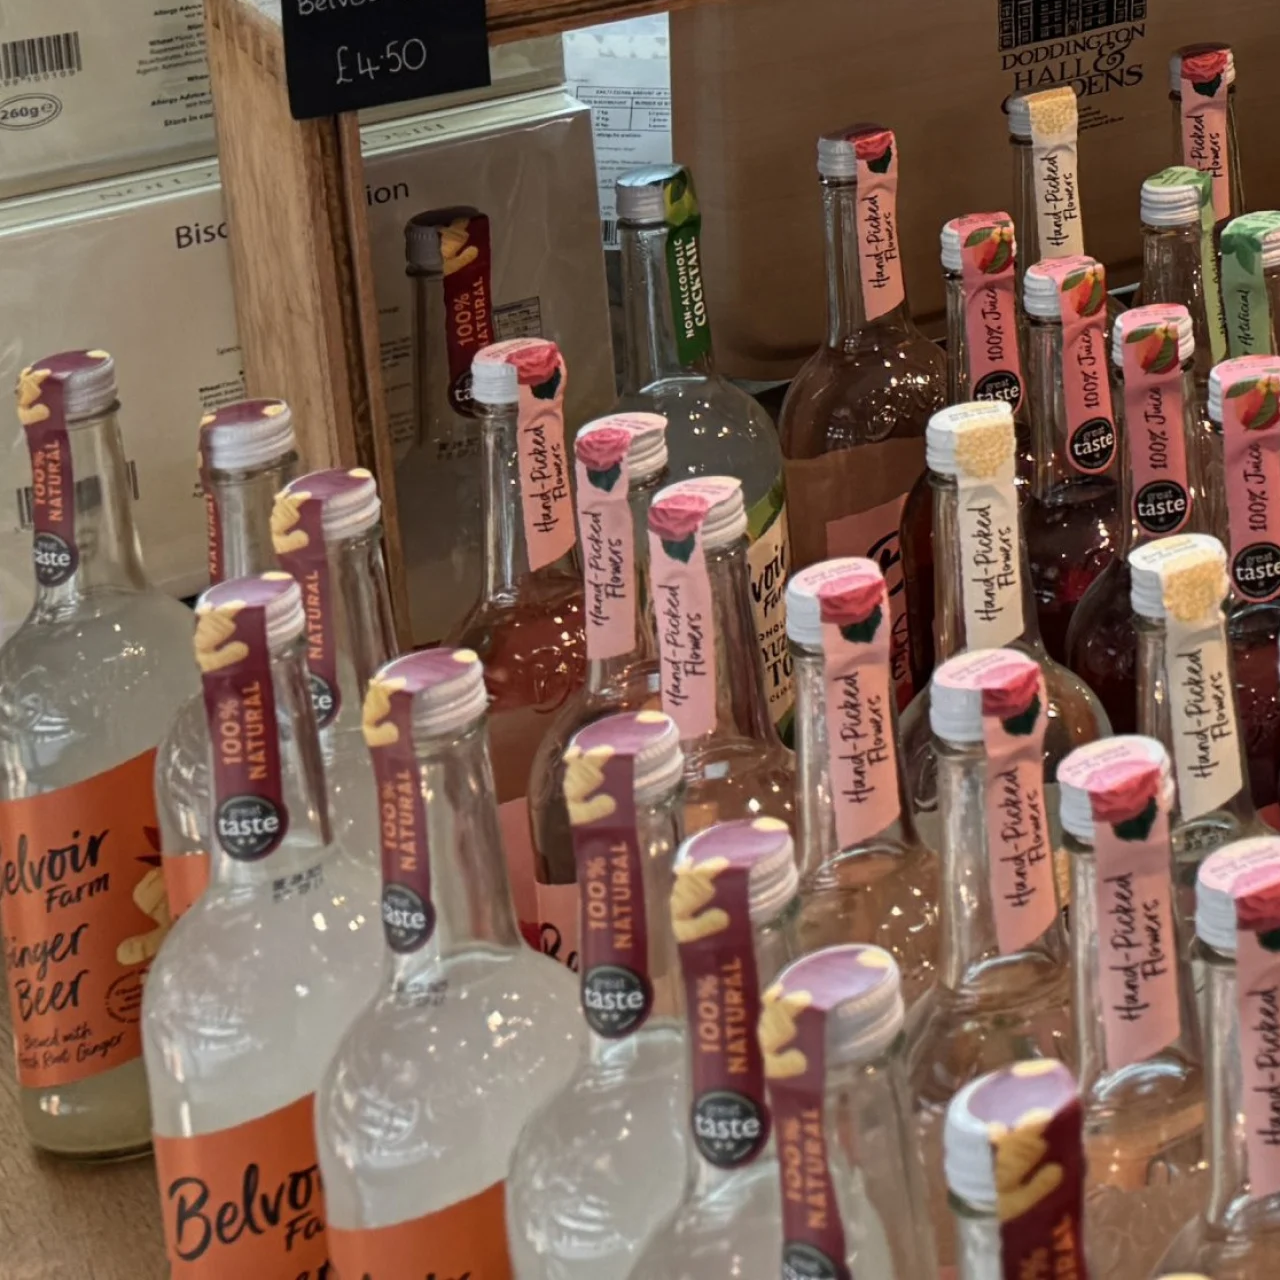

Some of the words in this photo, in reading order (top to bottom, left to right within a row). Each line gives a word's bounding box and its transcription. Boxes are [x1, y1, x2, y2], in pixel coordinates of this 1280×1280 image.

[336, 38, 427, 85] £4.50
[1001, 24, 1145, 71] DODDINGTON
[1014, 58, 1091, 91] HALL
[1093, 40, 1132, 72] &
[0, 107, 39, 120] 260g
[863, 194, 888, 290] Hand-Picked
[1044, 153, 1064, 249] Hand-Picked
[673, 236, 695, 340] NON-ALCOHOLIC
[685, 236, 706, 327] COCKTAIL
[48, 439, 63, 522] NATURAL
[529, 422, 551, 534] Hand-Picked
[1073, 432, 1114, 456] taste
[1137, 496, 1186, 518] taste
[972, 503, 993, 624] Hand-Picked
[308, 569, 324, 661] NATURAL
[833, 671, 874, 806] Hand-Picked
[1176, 648, 1219, 779] Hand-Picked
[0, 829, 110, 898] elvoir
[218, 814, 280, 837] taste
[997, 766, 1032, 909] Hand-Picked
[44, 872, 110, 914] Farm
[611, 842, 633, 949] NATURAL
[1104, 871, 1149, 1022] Hand-Picked
[15, 969, 90, 1022] Beer
[585, 989, 644, 1010] taste
[700, 974, 720, 1054] 100%
[723, 956, 748, 1075] NATURAL
[695, 1117, 760, 1140] taste
[804, 1106, 829, 1230] NATURAL
